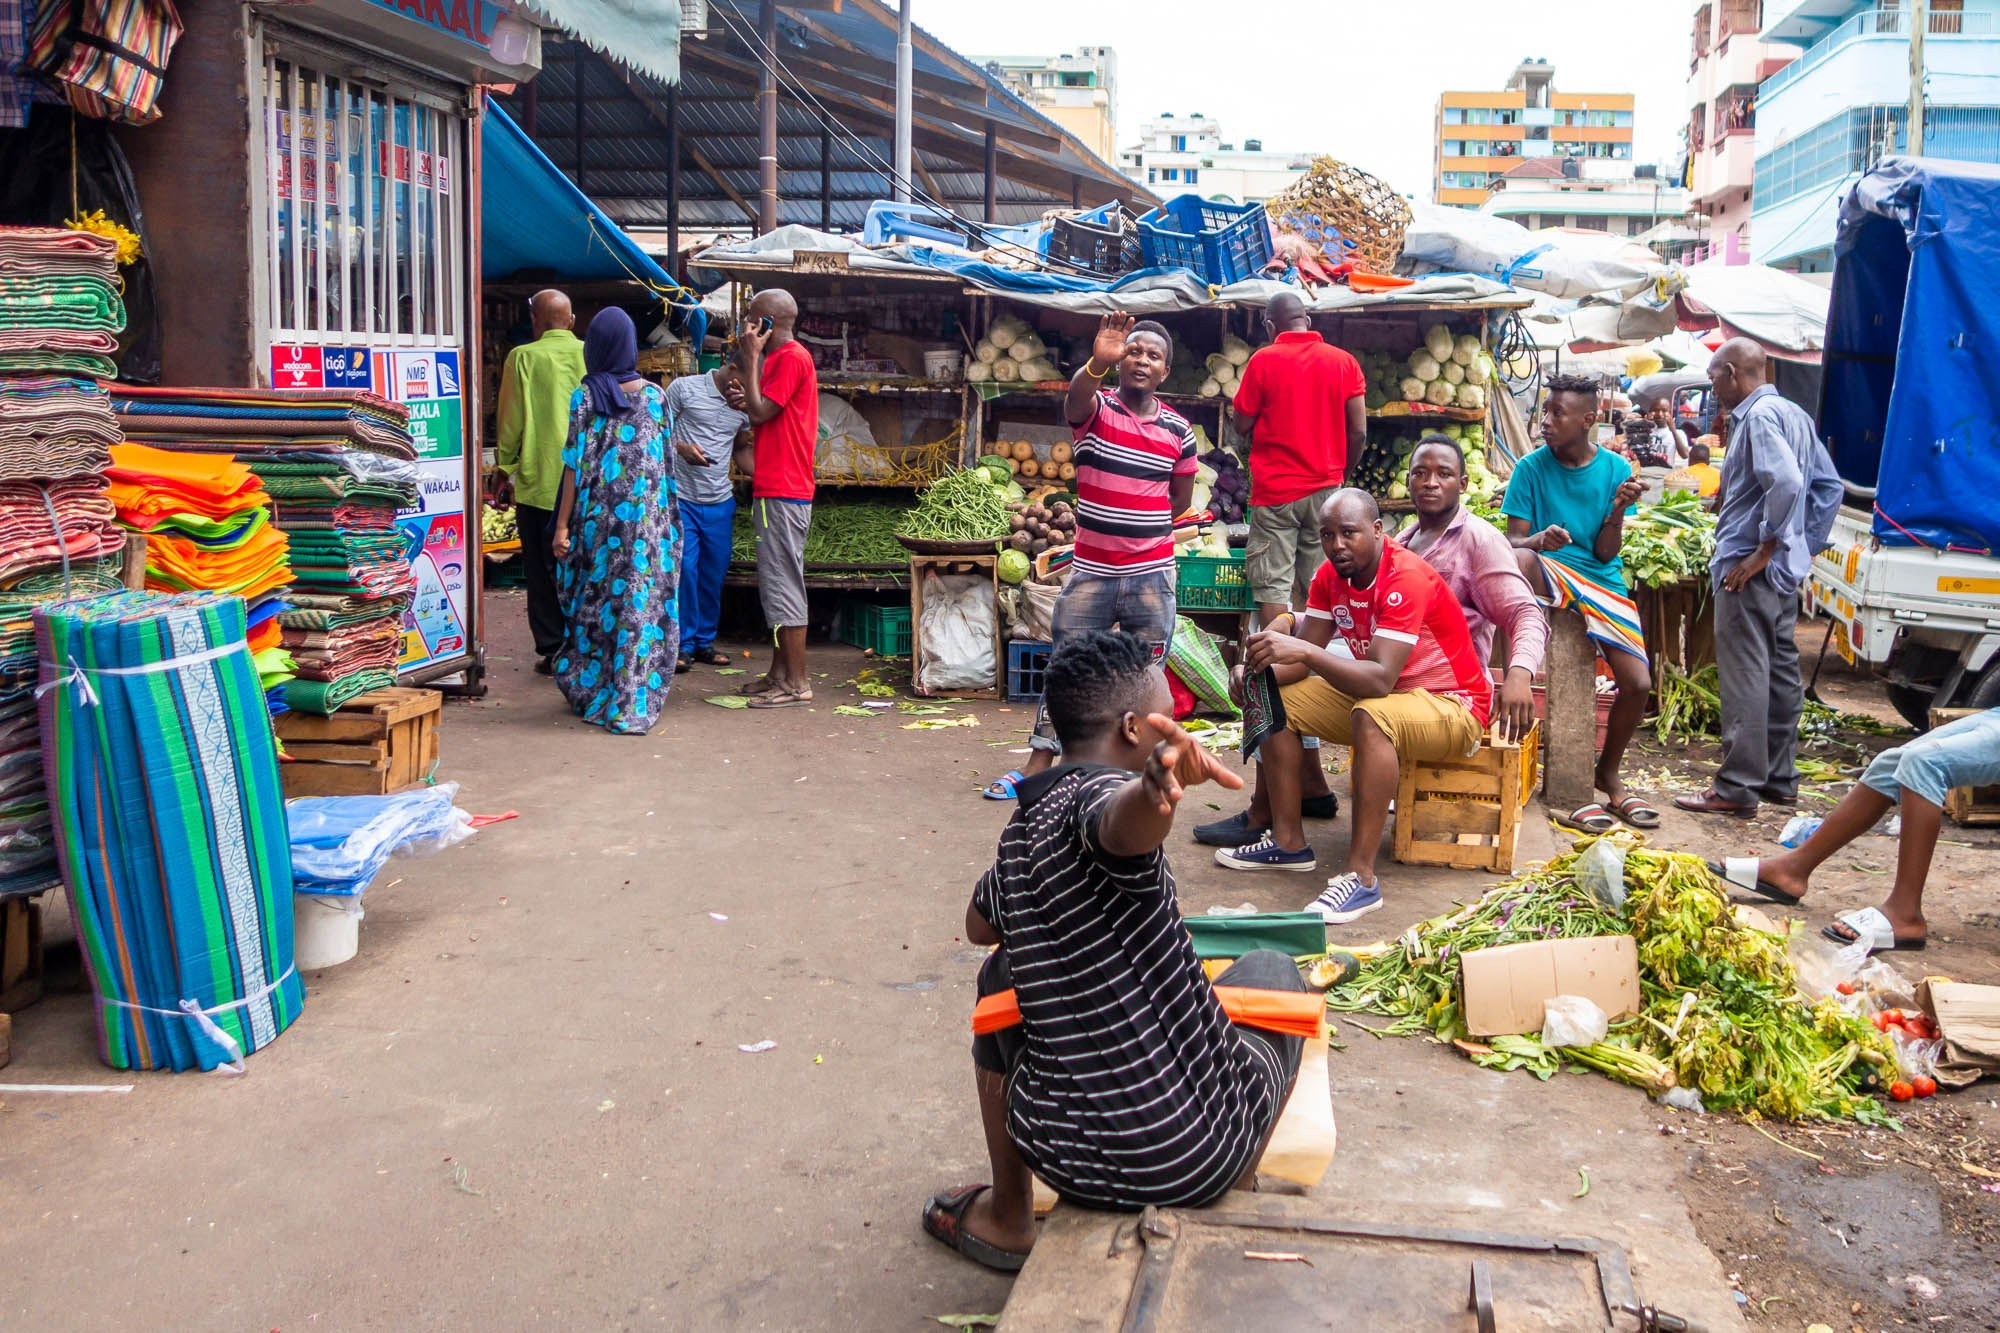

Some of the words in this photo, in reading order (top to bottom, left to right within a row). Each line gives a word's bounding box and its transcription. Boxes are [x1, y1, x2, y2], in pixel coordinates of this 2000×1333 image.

[283, 361, 312, 370] vodacom
[406, 366, 425, 380] NMB
[424, 479, 461, 495] WAKALA
